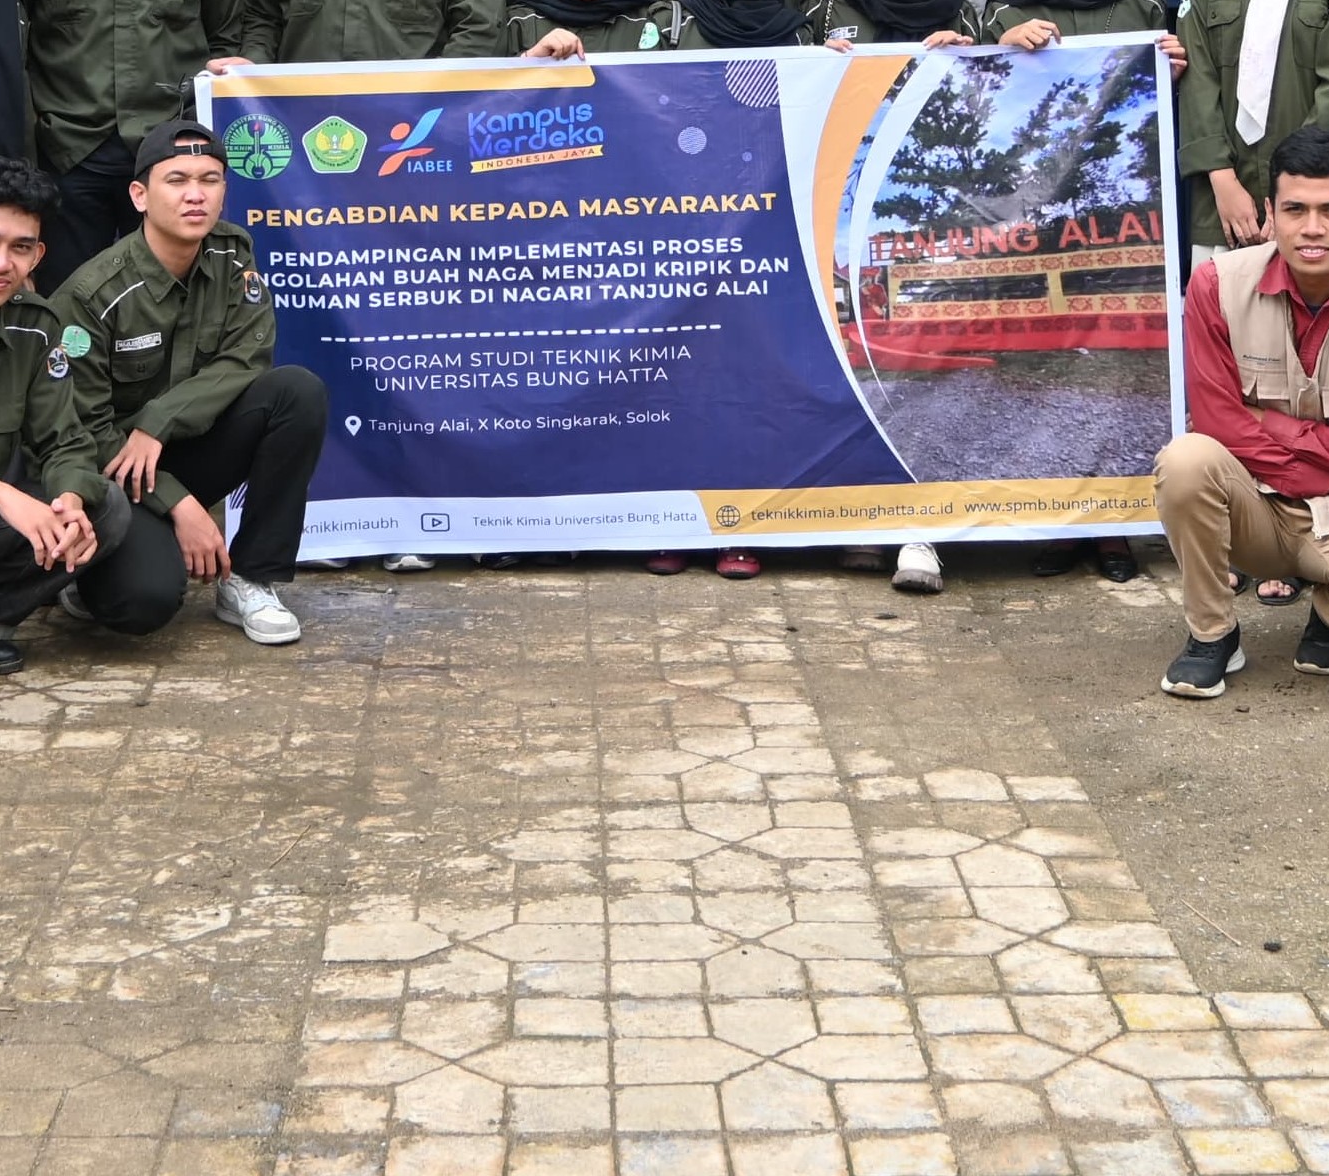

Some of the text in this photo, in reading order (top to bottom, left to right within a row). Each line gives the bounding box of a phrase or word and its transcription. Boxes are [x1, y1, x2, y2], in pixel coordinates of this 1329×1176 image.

[467, 103, 593, 137] Kampus
[224, 144, 253, 152] TEKNIK
[469, 125, 604, 158] Merdeka
[407, 159, 453, 174] IABEE
[480, 147, 596, 170] INDONESIA JAYA
[247, 192, 777, 227] PENGABDIAN KEPADA MASYARAKAT
[868, 210, 1164, 260] TANJUNG ALAI
[269, 237, 744, 267] PENDAMPINGAN IMPLEMENTASI PROSES
[259, 257, 789, 289] NGOLAHAN BUAH NAGA MENJADI KRIPIK DAN
[274, 279, 768, 310] NUMAN SERBUK DI NAGARI TANJUNG ALAI
[350, 344, 692, 372] PROGRAM STUDI TEKNIK KIMIA
[374, 366, 669, 392] UNIVERSITAS BUNG HATTA
[368, 409, 671, 435] Tanjung Alai, X Koto Singkarak, Solok
[751, 502, 954, 521] teknikkimia.bunghatta.ac.id
[964, 496, 1156, 514] www.spmb.bunghatta.ac.i
[302, 516, 399, 535] knikkimiaubh
[473, 511, 698, 528] Teknik Kimia Universitas Bung Hatta
